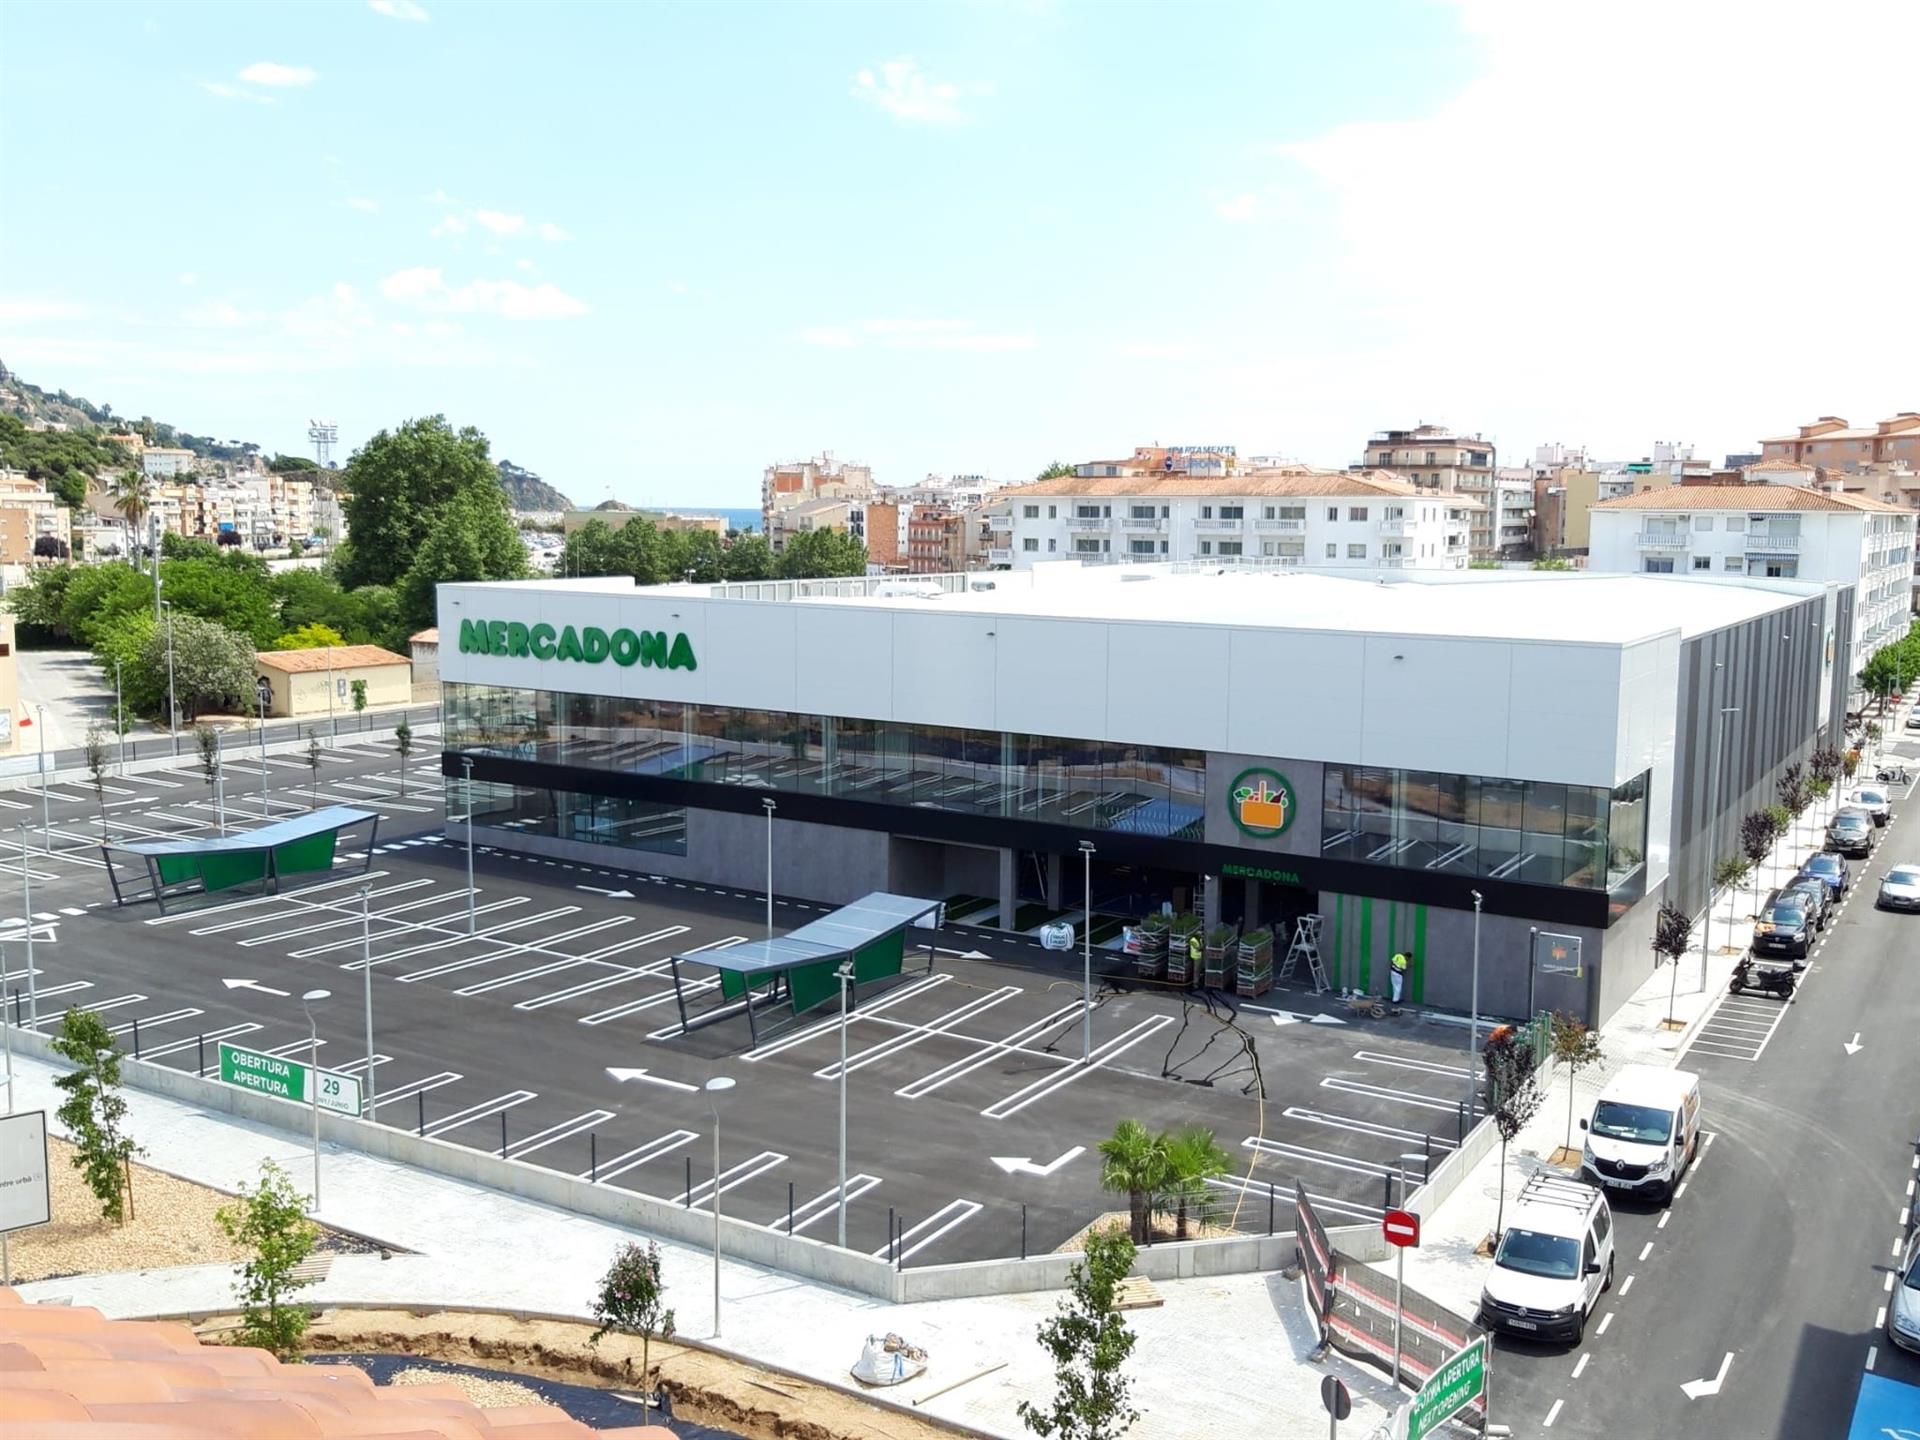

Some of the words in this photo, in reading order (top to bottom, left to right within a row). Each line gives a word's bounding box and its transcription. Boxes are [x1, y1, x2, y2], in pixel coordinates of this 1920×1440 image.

[459, 618, 697, 672] MERCADONA
[1221, 864, 1299, 882] MERCADONA
[231, 1052, 290, 1078] OBERTURA
[233, 1070, 289, 1096] APERTURA
[323, 1078, 340, 1096] 29
[1442, 1349, 1480, 1390] APERTURA
[1418, 1406, 1437, 1434] NEXT
[1438, 1379, 1472, 1416] OPENING
